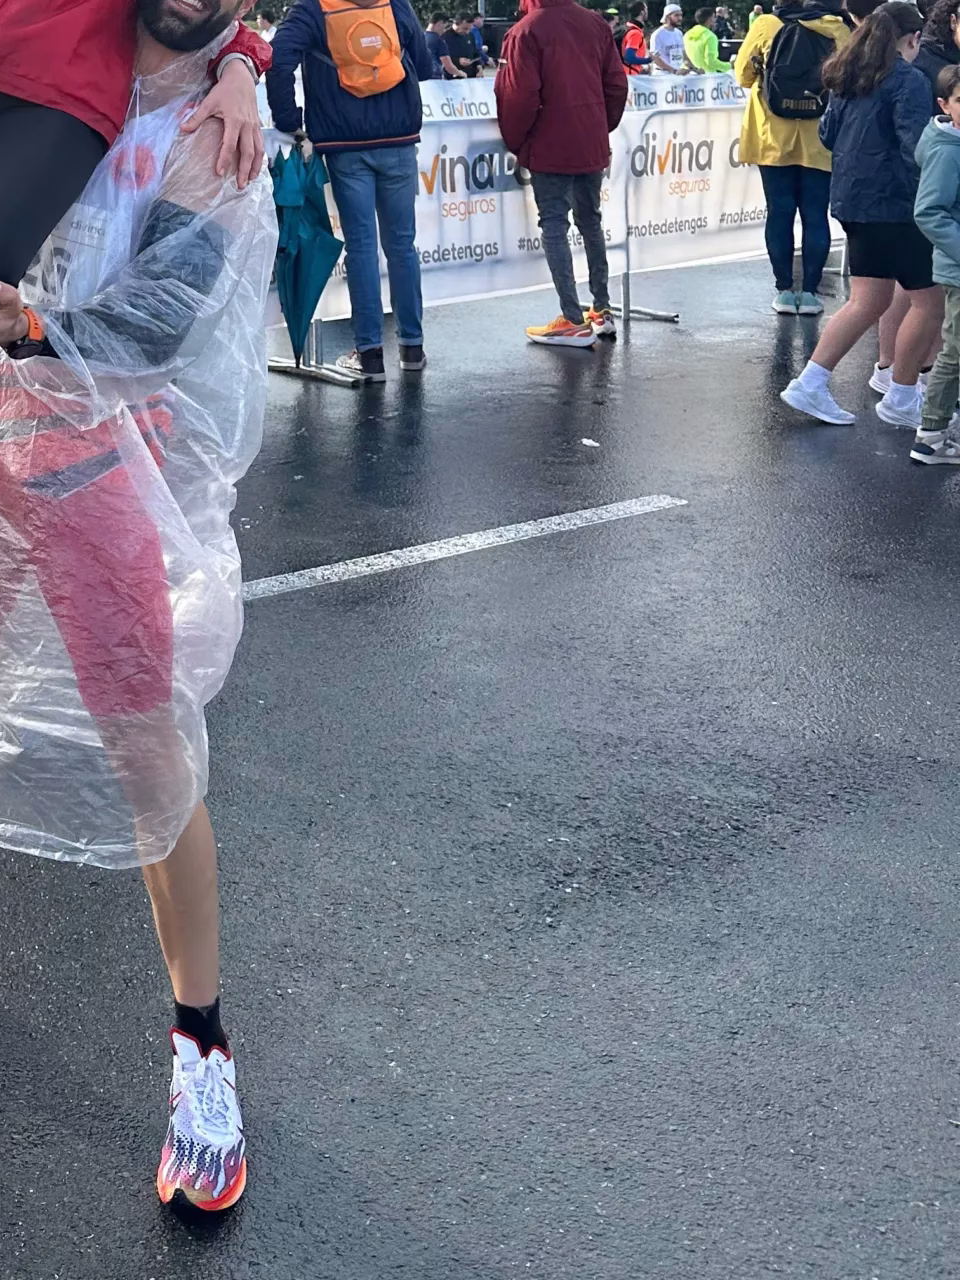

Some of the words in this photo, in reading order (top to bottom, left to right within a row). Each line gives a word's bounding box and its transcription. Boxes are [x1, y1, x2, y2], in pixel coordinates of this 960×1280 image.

[665, 84, 705, 105] divina
[441, 97, 491, 118] divina
[630, 131, 715, 178] divina
[669, 178, 711, 198] seguros
[441, 197, 497, 222] seguros
[720, 204, 768, 225] #notedet
[627, 215, 708, 238] #notedetengas
